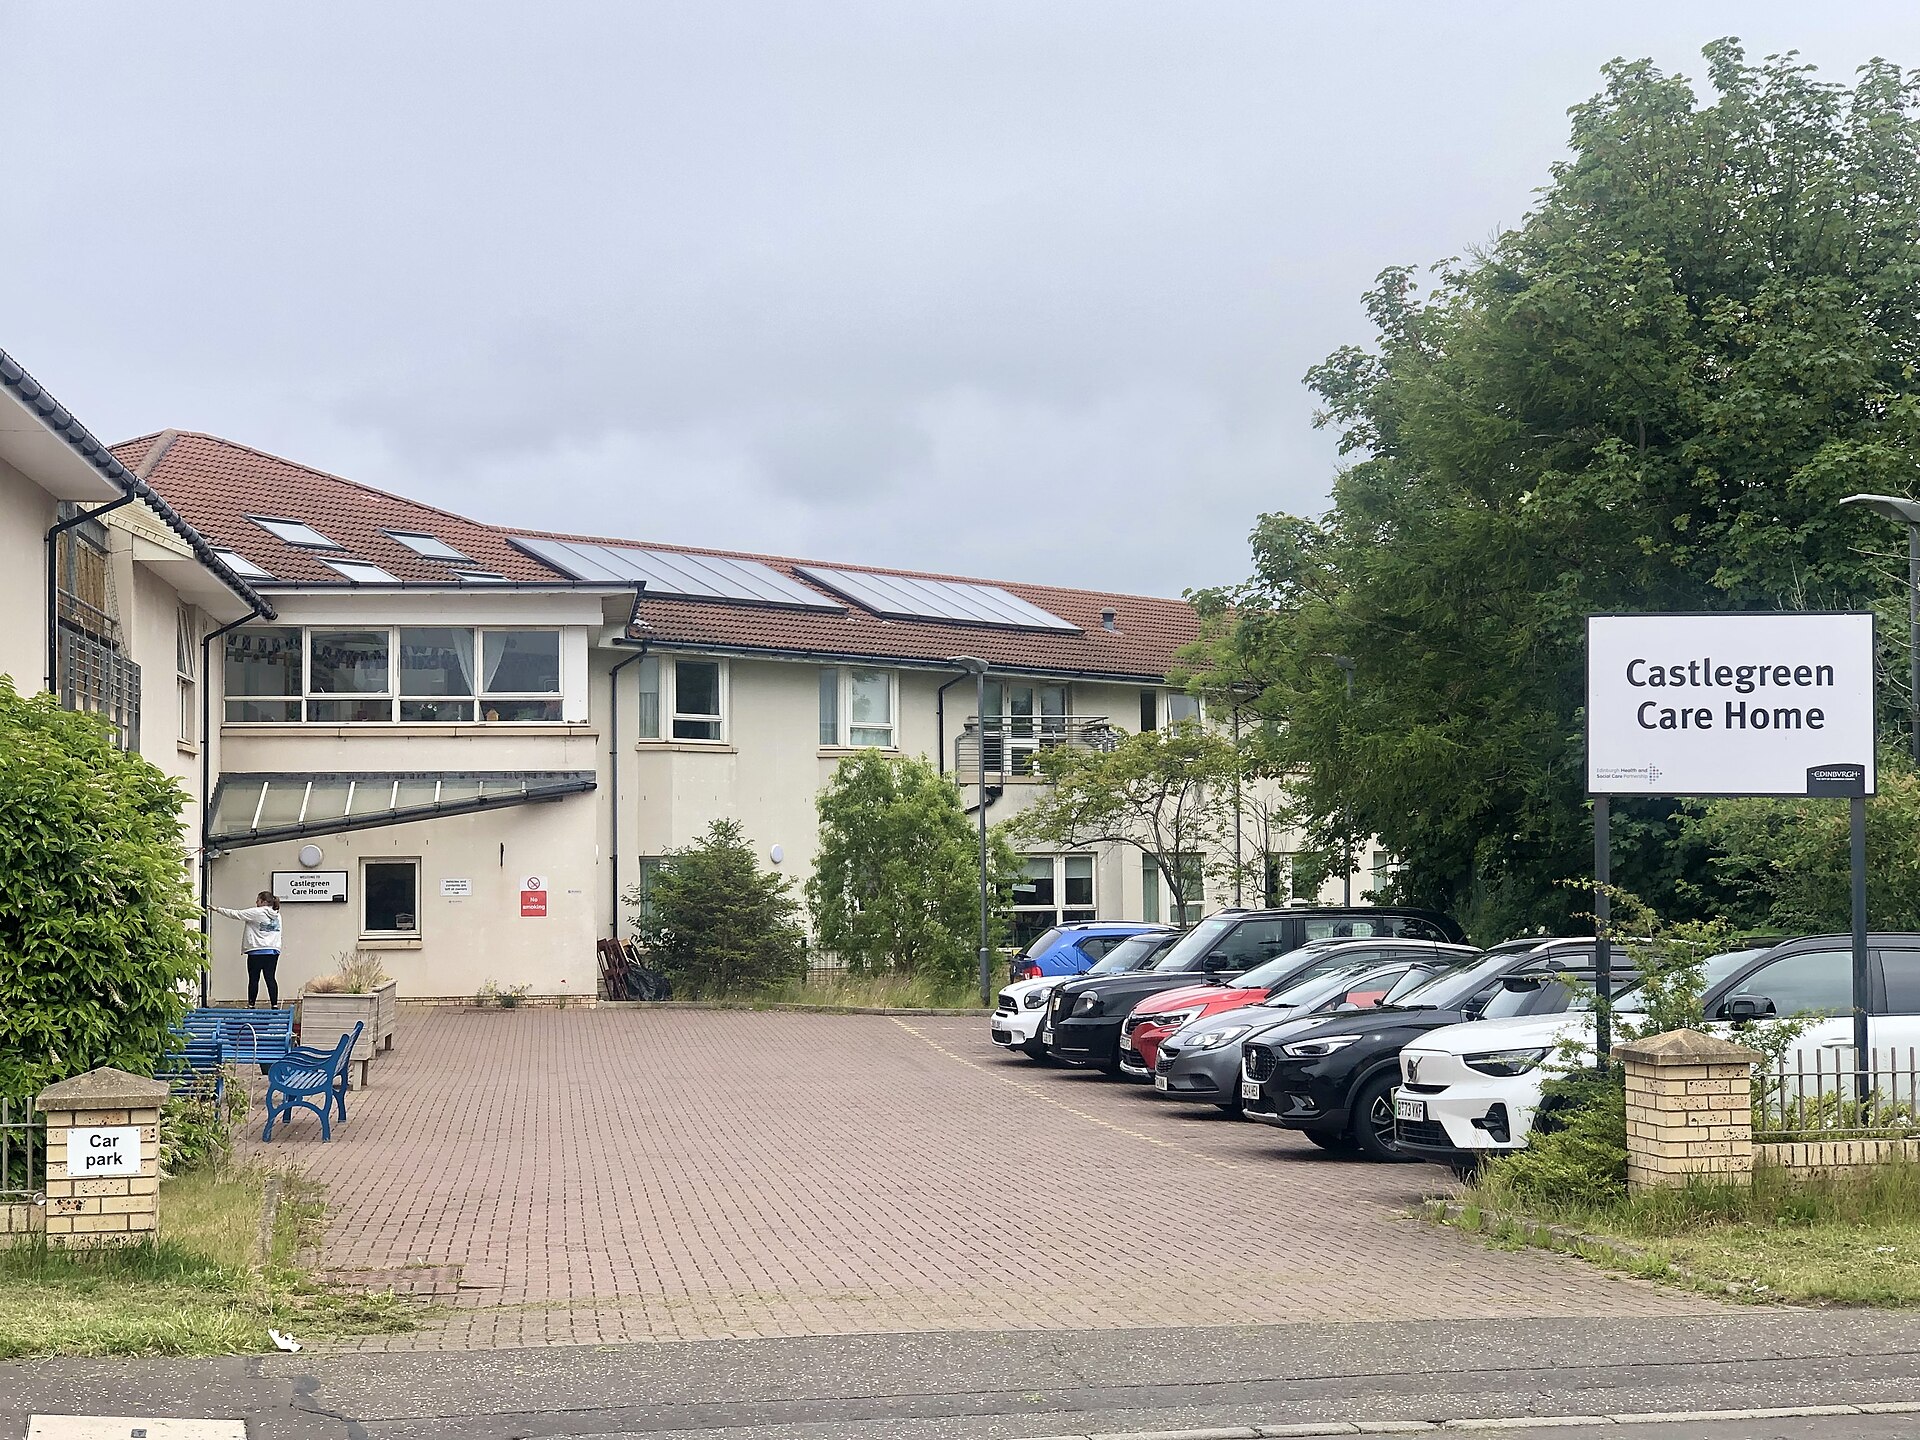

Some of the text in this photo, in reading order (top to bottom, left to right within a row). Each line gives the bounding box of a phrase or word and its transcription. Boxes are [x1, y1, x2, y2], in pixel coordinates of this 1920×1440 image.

[1626, 658, 1834, 694] Castlegreen
[1637, 701, 1825, 730] Care Home
[89, 1134, 119, 1148] Car
[86, 1152, 123, 1169] park
